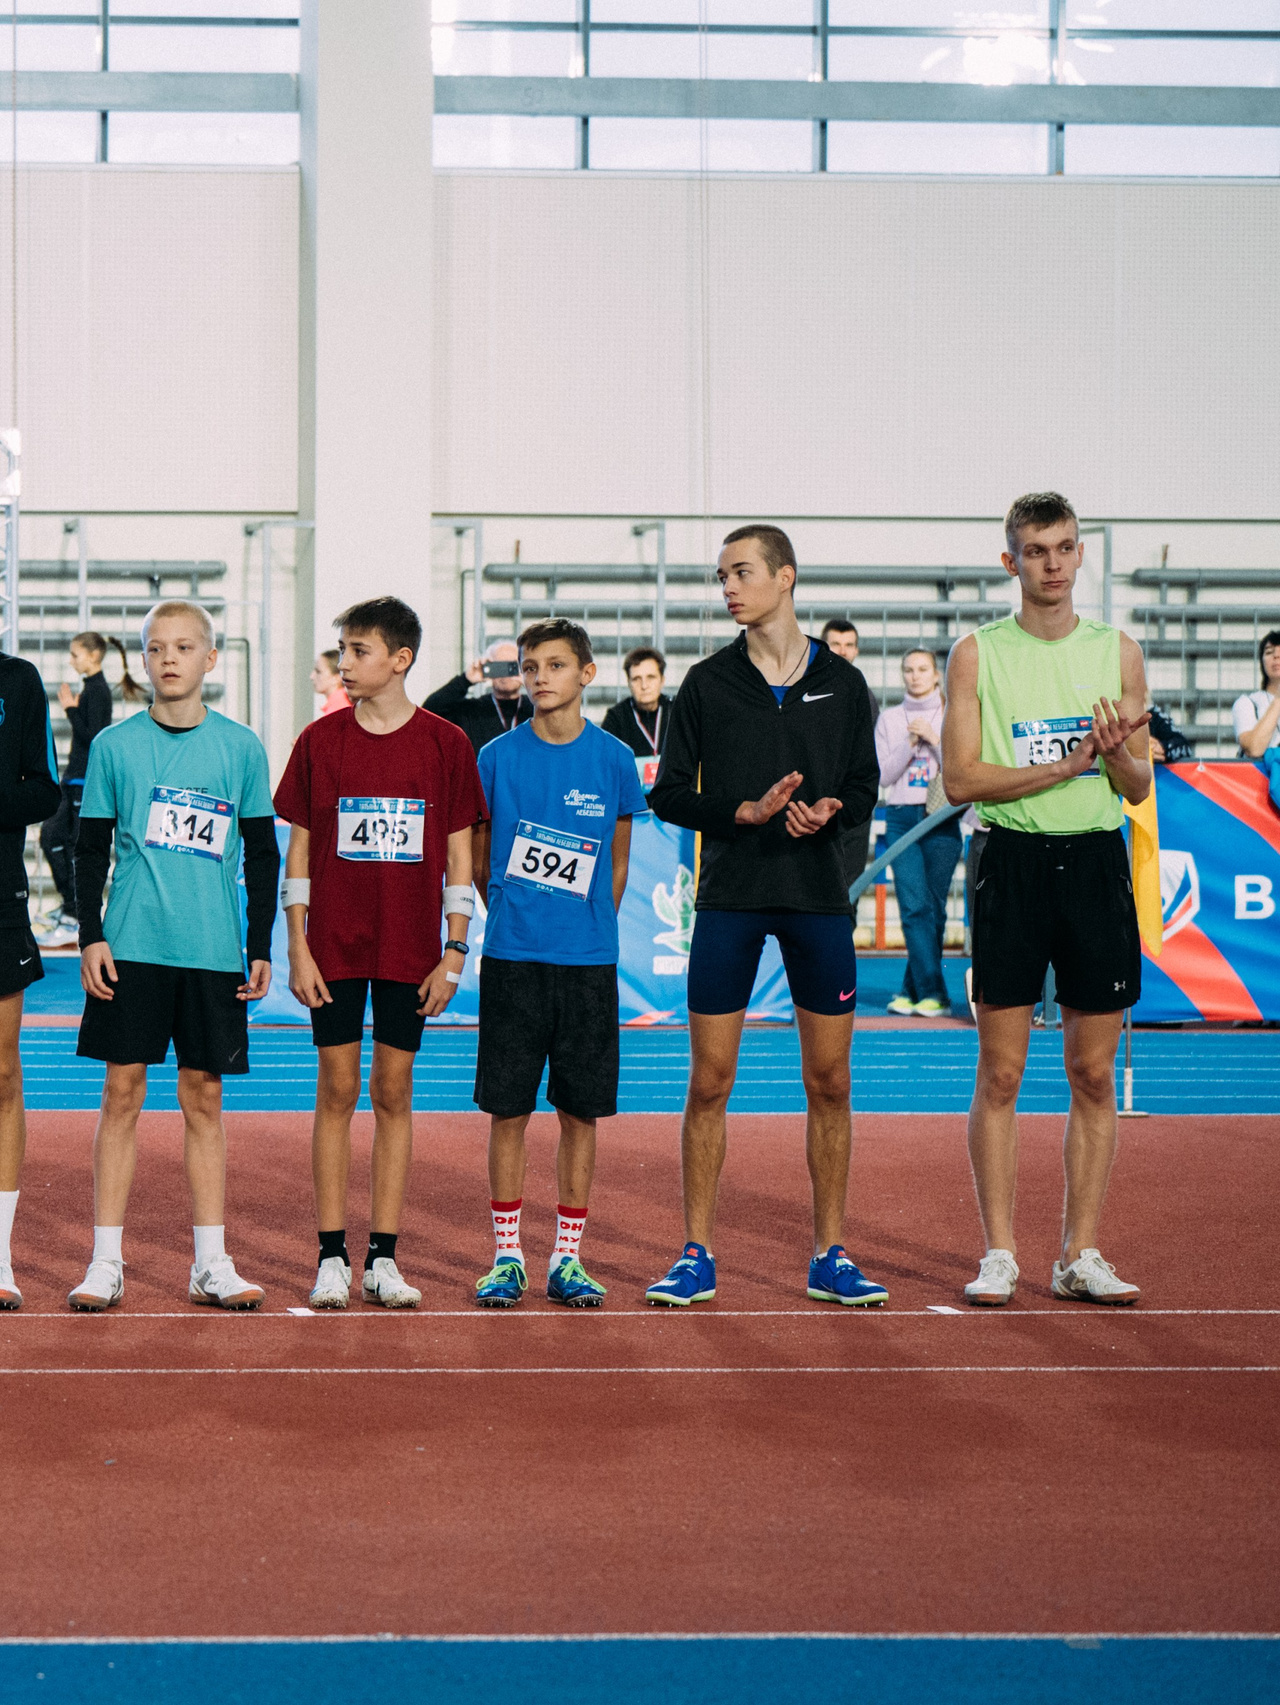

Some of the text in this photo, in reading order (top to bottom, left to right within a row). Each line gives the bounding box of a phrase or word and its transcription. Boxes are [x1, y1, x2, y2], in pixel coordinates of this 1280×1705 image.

[160, 809, 214, 845] 314
[351, 818, 409, 846] 495
[522, 845, 578, 884] 594
[494, 1215, 518, 1225] OH
[560, 1221, 583, 1231] OH
[558, 1235, 579, 1243] MY
